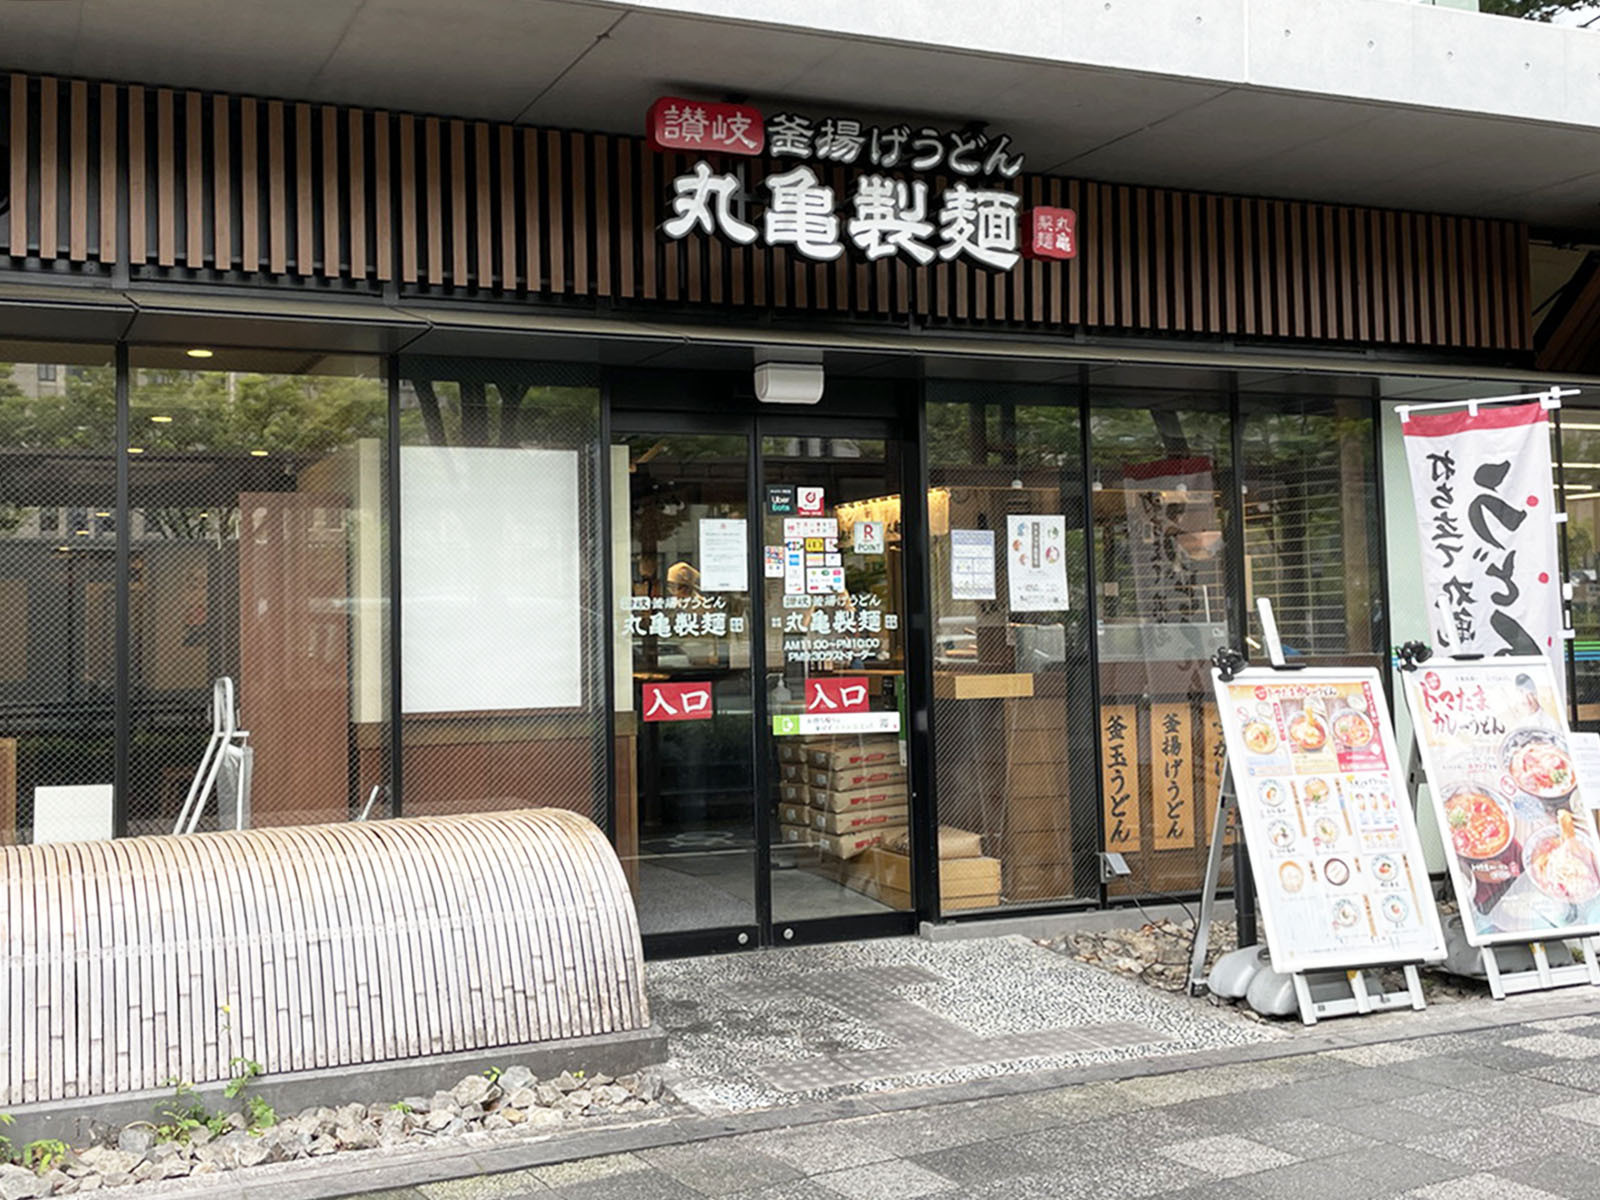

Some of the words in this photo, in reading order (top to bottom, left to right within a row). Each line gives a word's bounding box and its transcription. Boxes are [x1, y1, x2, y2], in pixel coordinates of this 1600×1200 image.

[663, 104, 758, 149] 讃岐
[767, 113, 1025, 179] 釜揚げうどん
[661, 161, 1022, 272] 丸亀製麺
[863, 524, 874, 540] R
[858, 543, 881, 551] POINT
[621, 611, 727, 638] 丸亀製麺
[783, 609, 882, 635] 丸亀製麺
[645, 688, 709, 717] 入口
[808, 682, 867, 711] 入口
[1104, 713, 1130, 844] 釜玉うどん
[1161, 712, 1184, 841] 釜揚げうどん
